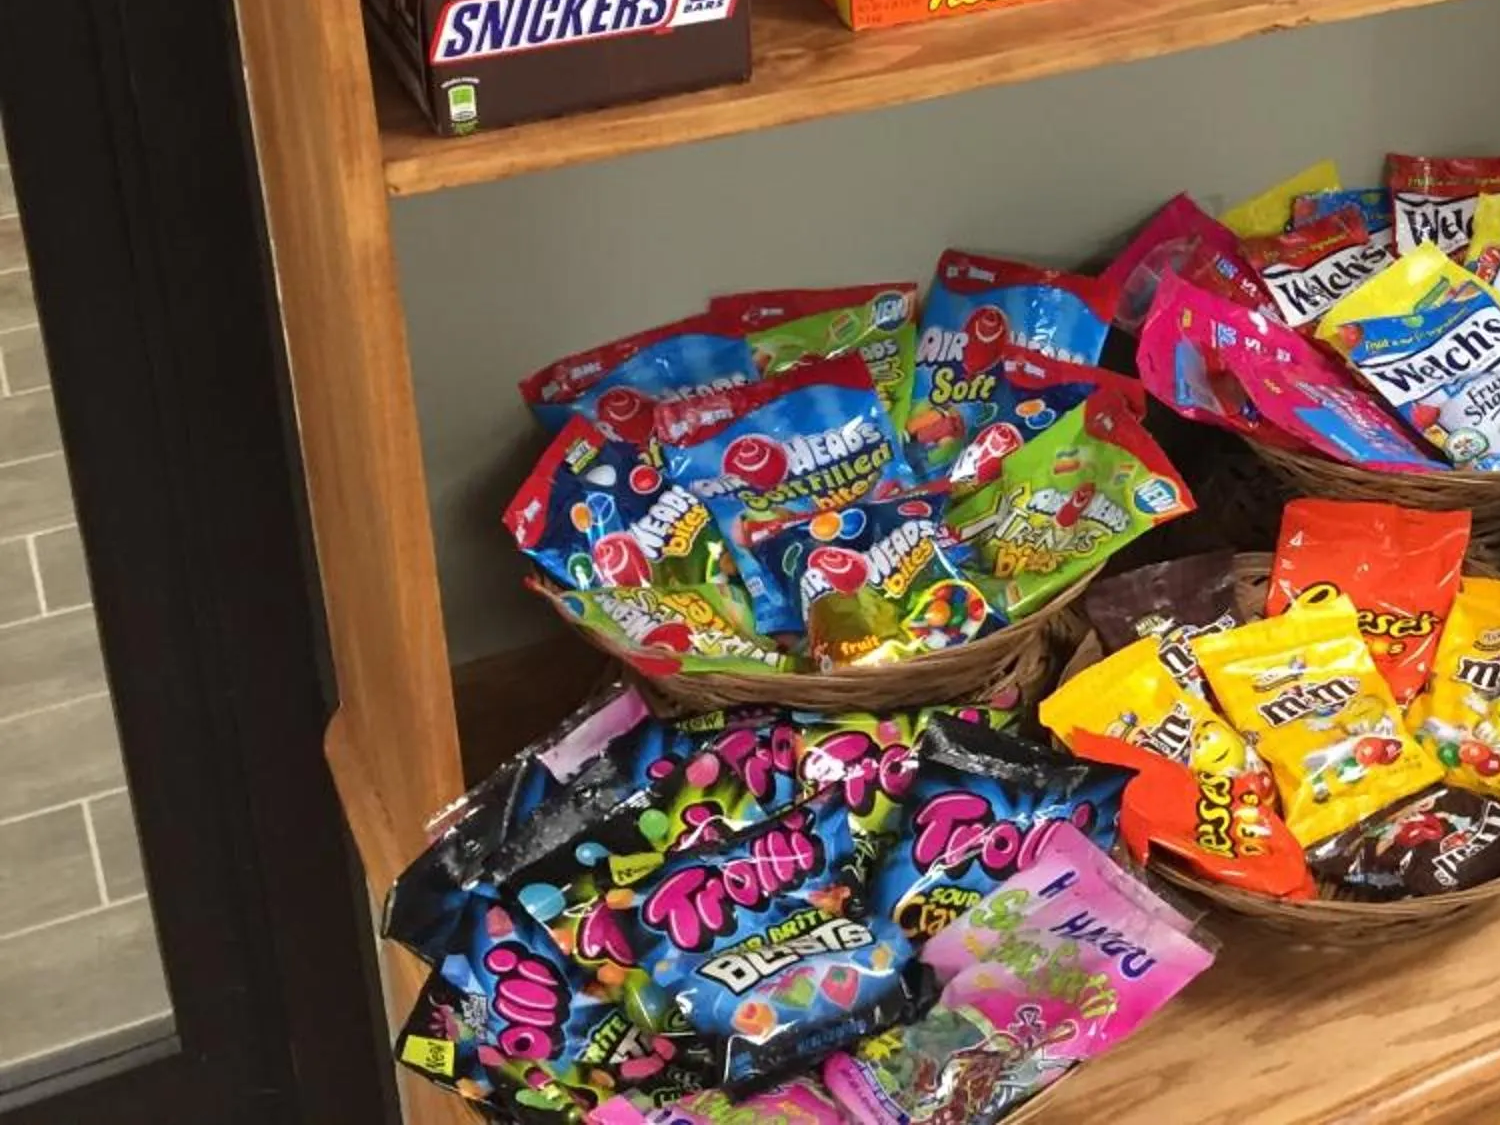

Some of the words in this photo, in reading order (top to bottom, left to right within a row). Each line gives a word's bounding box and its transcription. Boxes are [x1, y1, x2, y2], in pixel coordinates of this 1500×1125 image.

[683, 0, 724, 14] BARS
[917, 327, 968, 363] AIR
[931, 368, 996, 404] Soft
[787, 415, 881, 475] HEADS
[628, 484, 698, 559] HEADS
[868, 521, 934, 588] HEADS
[840, 635, 880, 655] fruit
[646, 809, 815, 949] Trolli
[486, 948, 558, 1061] olli
